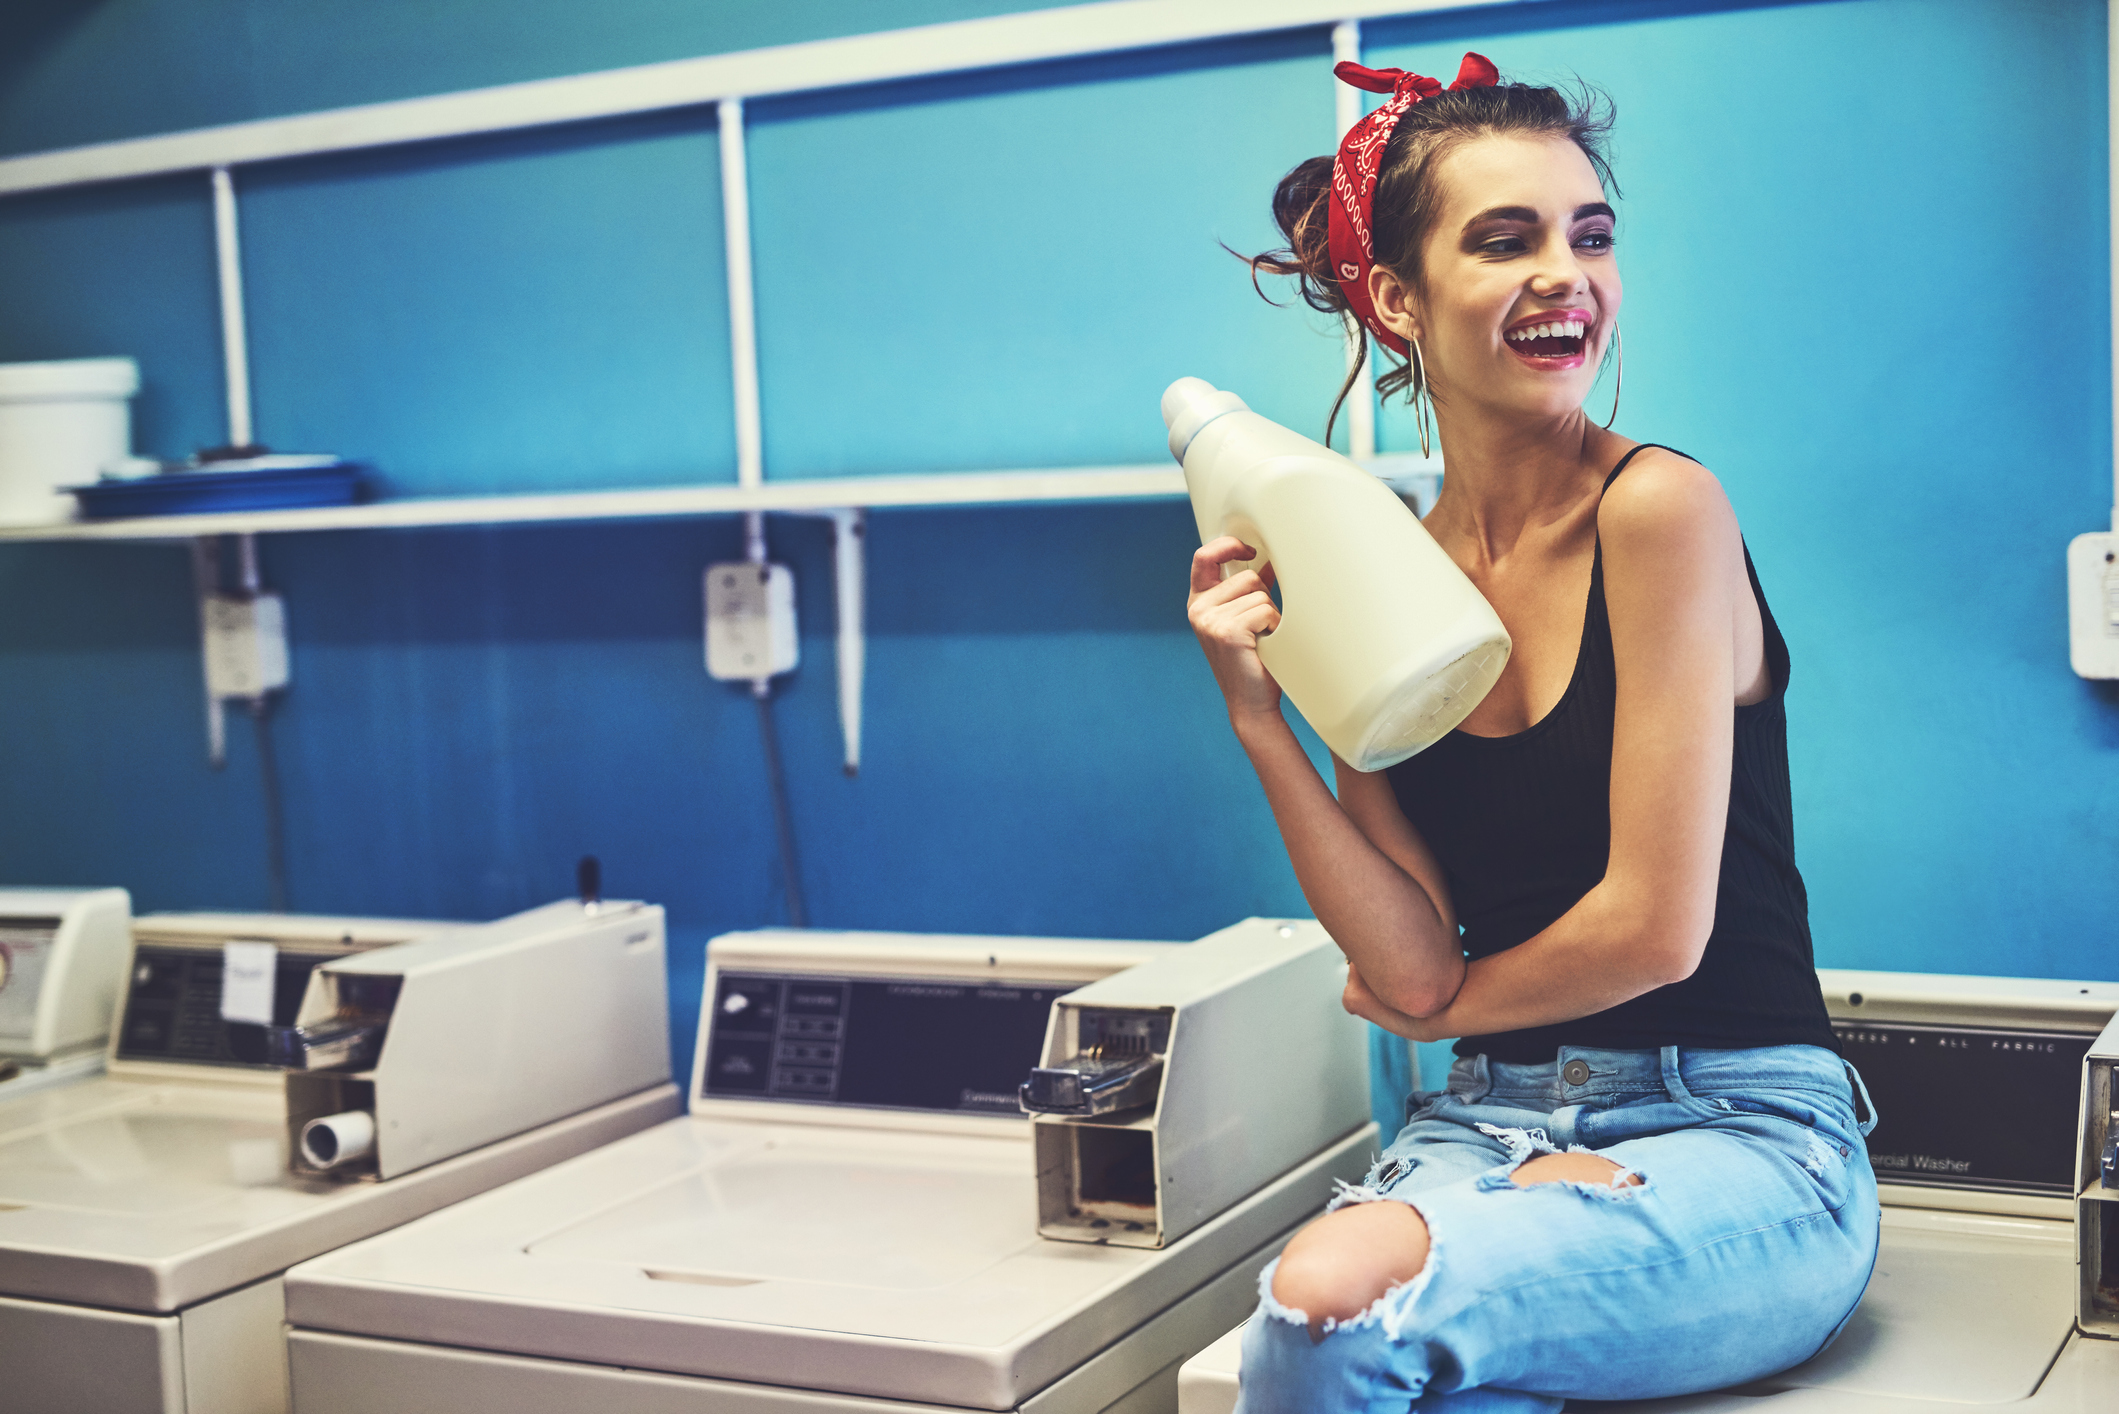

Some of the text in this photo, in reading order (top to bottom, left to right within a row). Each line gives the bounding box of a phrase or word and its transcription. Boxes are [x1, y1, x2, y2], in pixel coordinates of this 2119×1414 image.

[1938, 1037, 1969, 1049] ALL
[1991, 1040, 2055, 1053] FABRIC
[1869, 1153, 1971, 1173] ercial Washer
